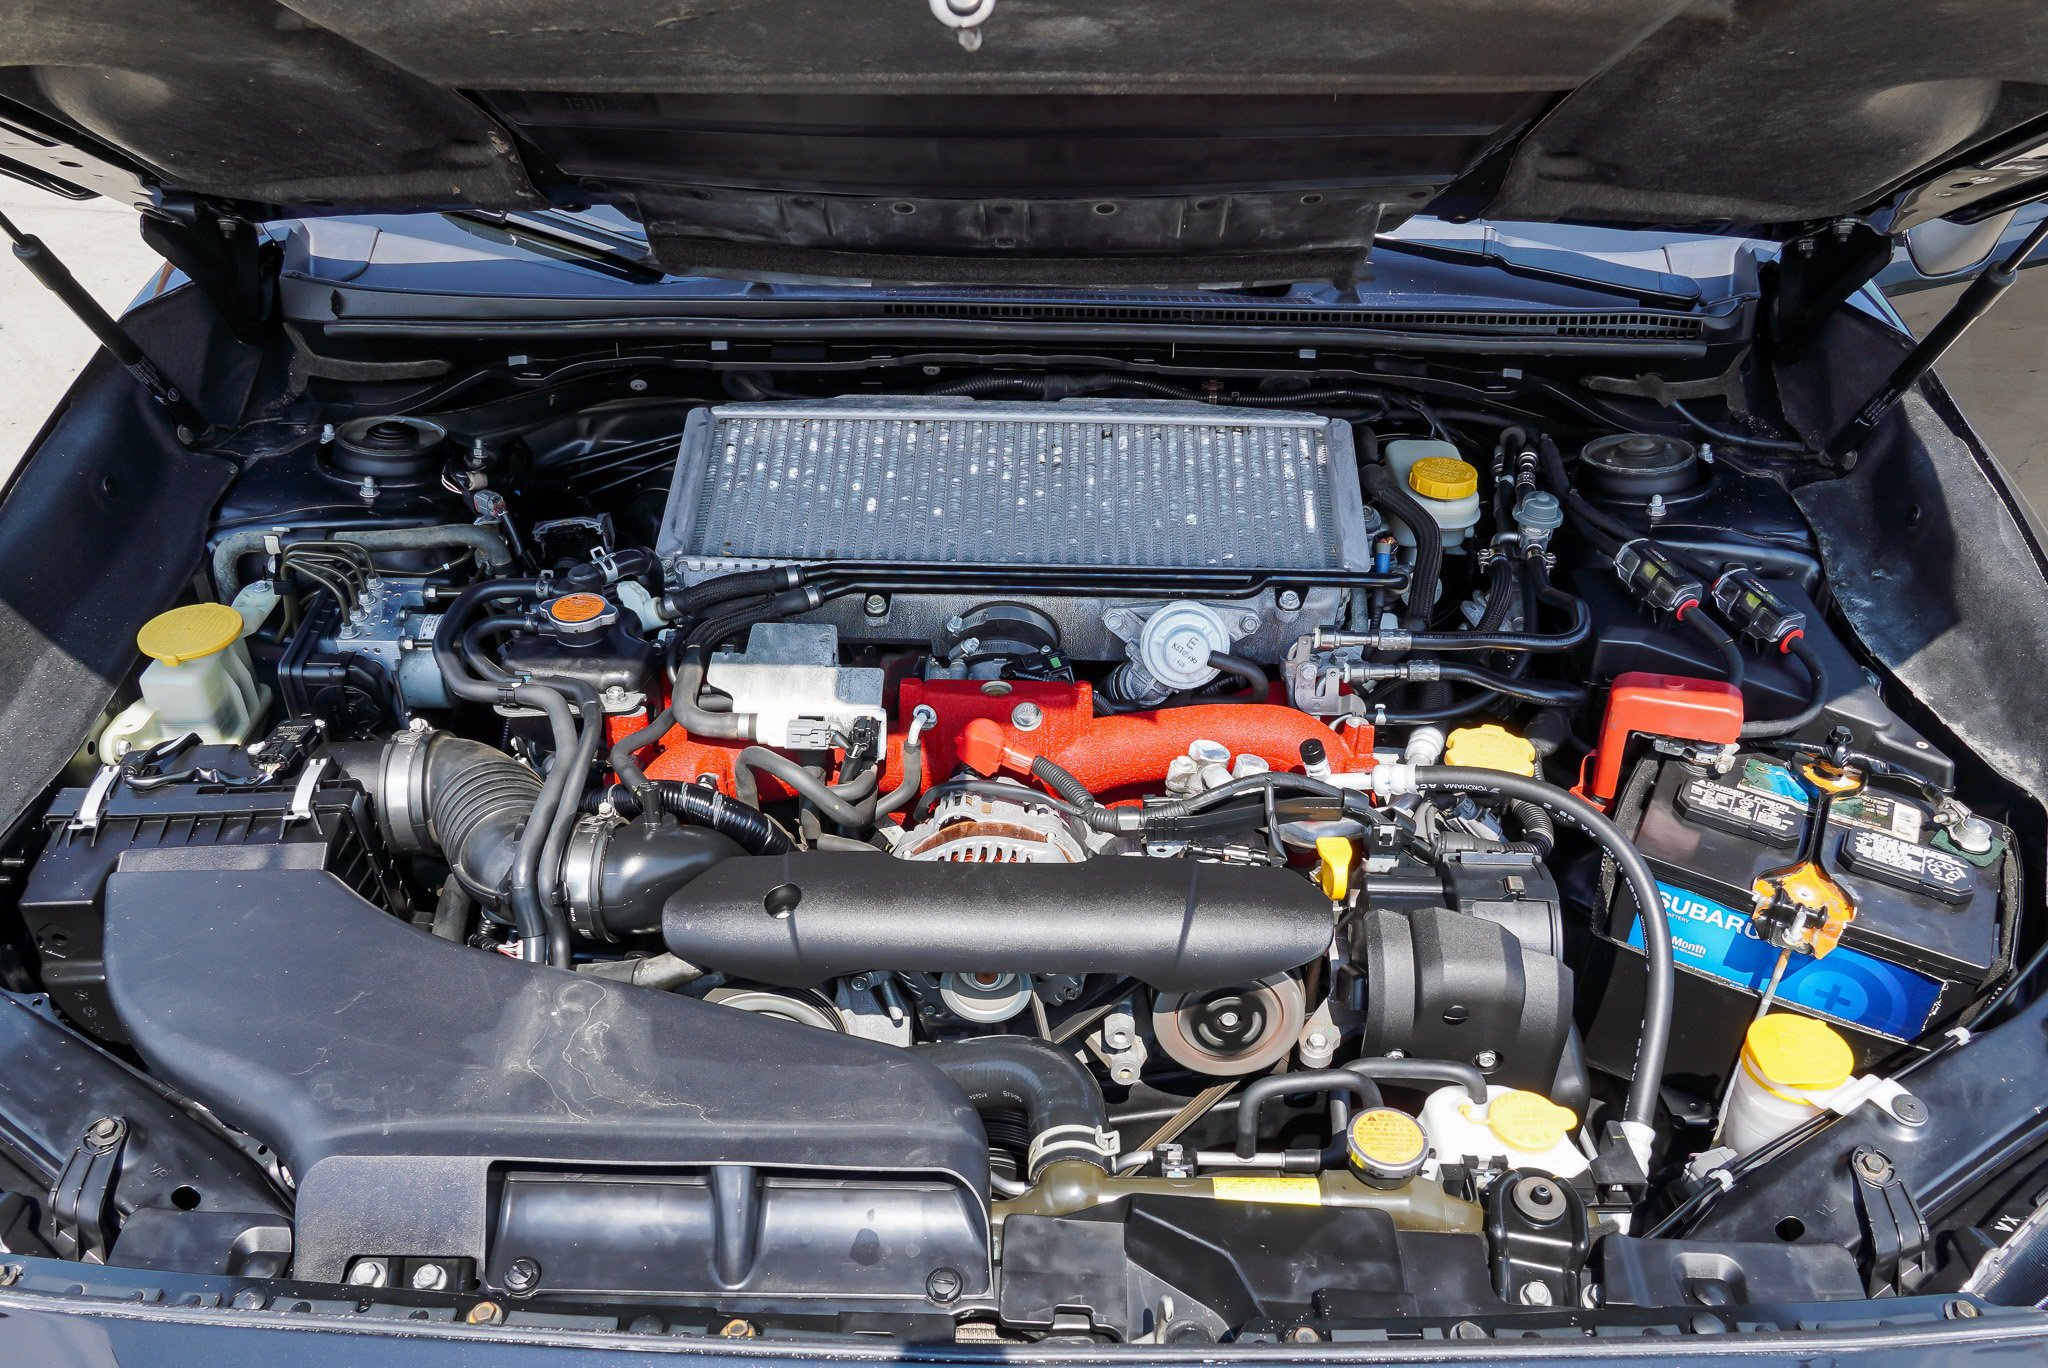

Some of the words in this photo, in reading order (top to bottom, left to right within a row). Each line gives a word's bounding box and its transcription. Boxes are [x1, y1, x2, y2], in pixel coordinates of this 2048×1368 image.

[1186, 637, 1199, 650] E
[1443, 783, 1488, 792] YOKOHAMA
[1706, 782, 1746, 798] DANGER
[1753, 795, 1791, 812] POISON
[1660, 891, 1760, 939] SUBARU
[1671, 935, 1707, 955] Month
